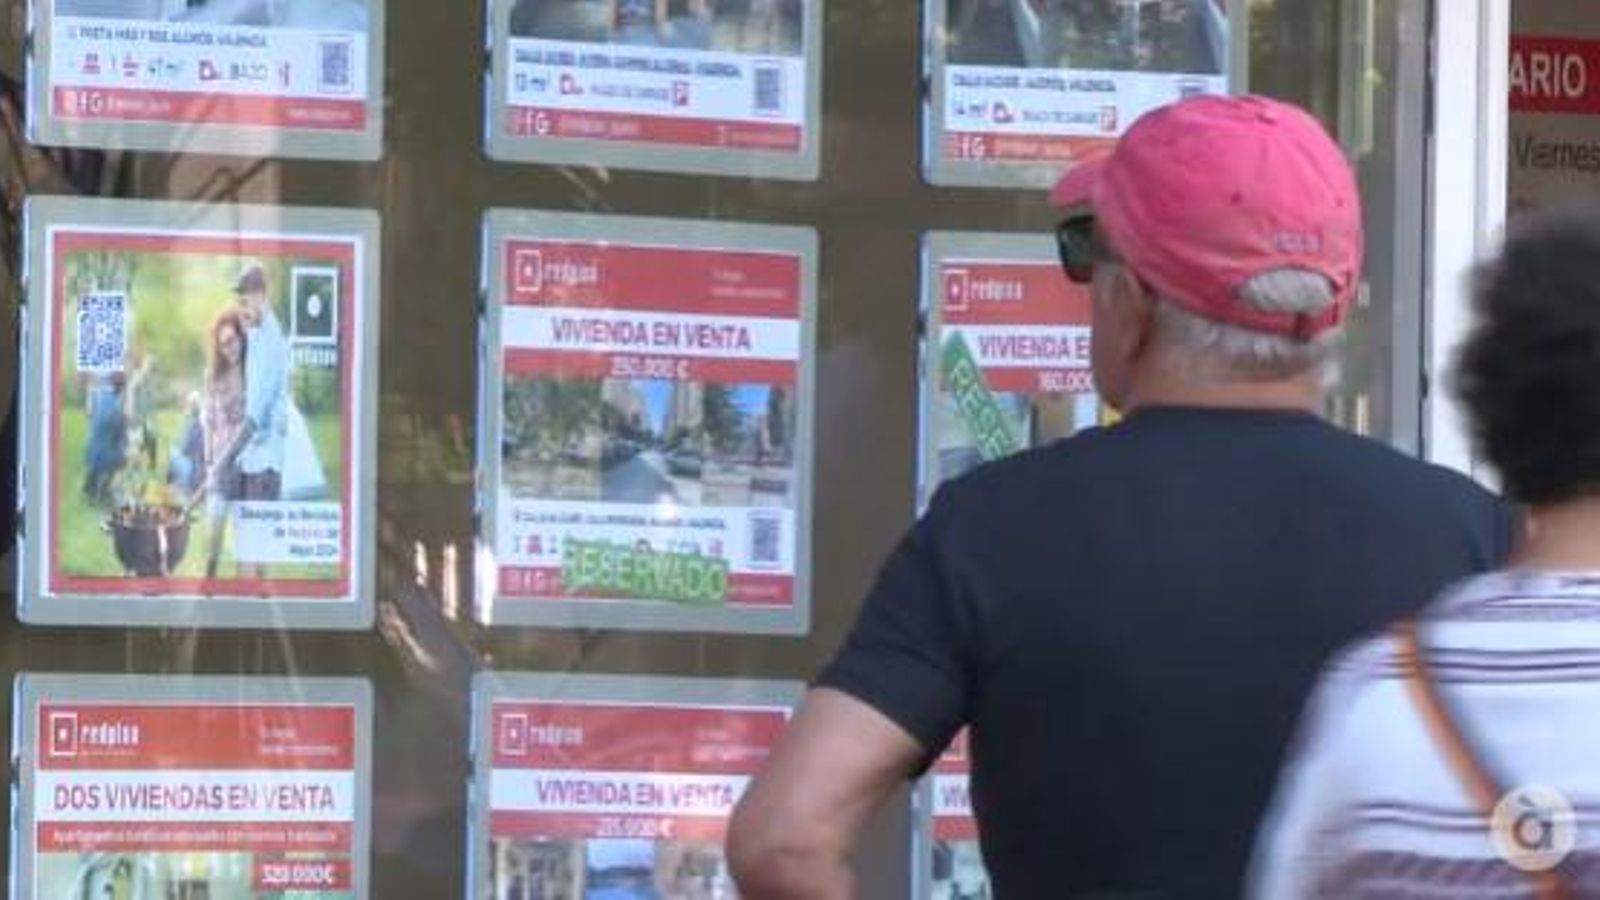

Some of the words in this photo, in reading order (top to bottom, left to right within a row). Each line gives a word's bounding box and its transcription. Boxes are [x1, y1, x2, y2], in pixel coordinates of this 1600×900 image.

[1509, 50, 1587, 98] ARIO
[551, 317, 648, 345] VIVIENDA
[653, 322, 681, 347] EN
[684, 323, 752, 351] VENTA
[977, 334, 1071, 358] VIVIENDA
[1075, 335, 1092, 360] E
[950, 358, 1013, 459] RESE
[563, 540, 726, 602] RESERVADO
[53, 783, 99, 810] DOS
[105, 783, 223, 810] VIVIENDAS
[229, 784, 257, 810] EN
[264, 784, 335, 811] VENTA
[536, 779, 632, 806] VIVIENDA
[636, 781, 664, 807] EN
[671, 783, 735, 809] VENTA
